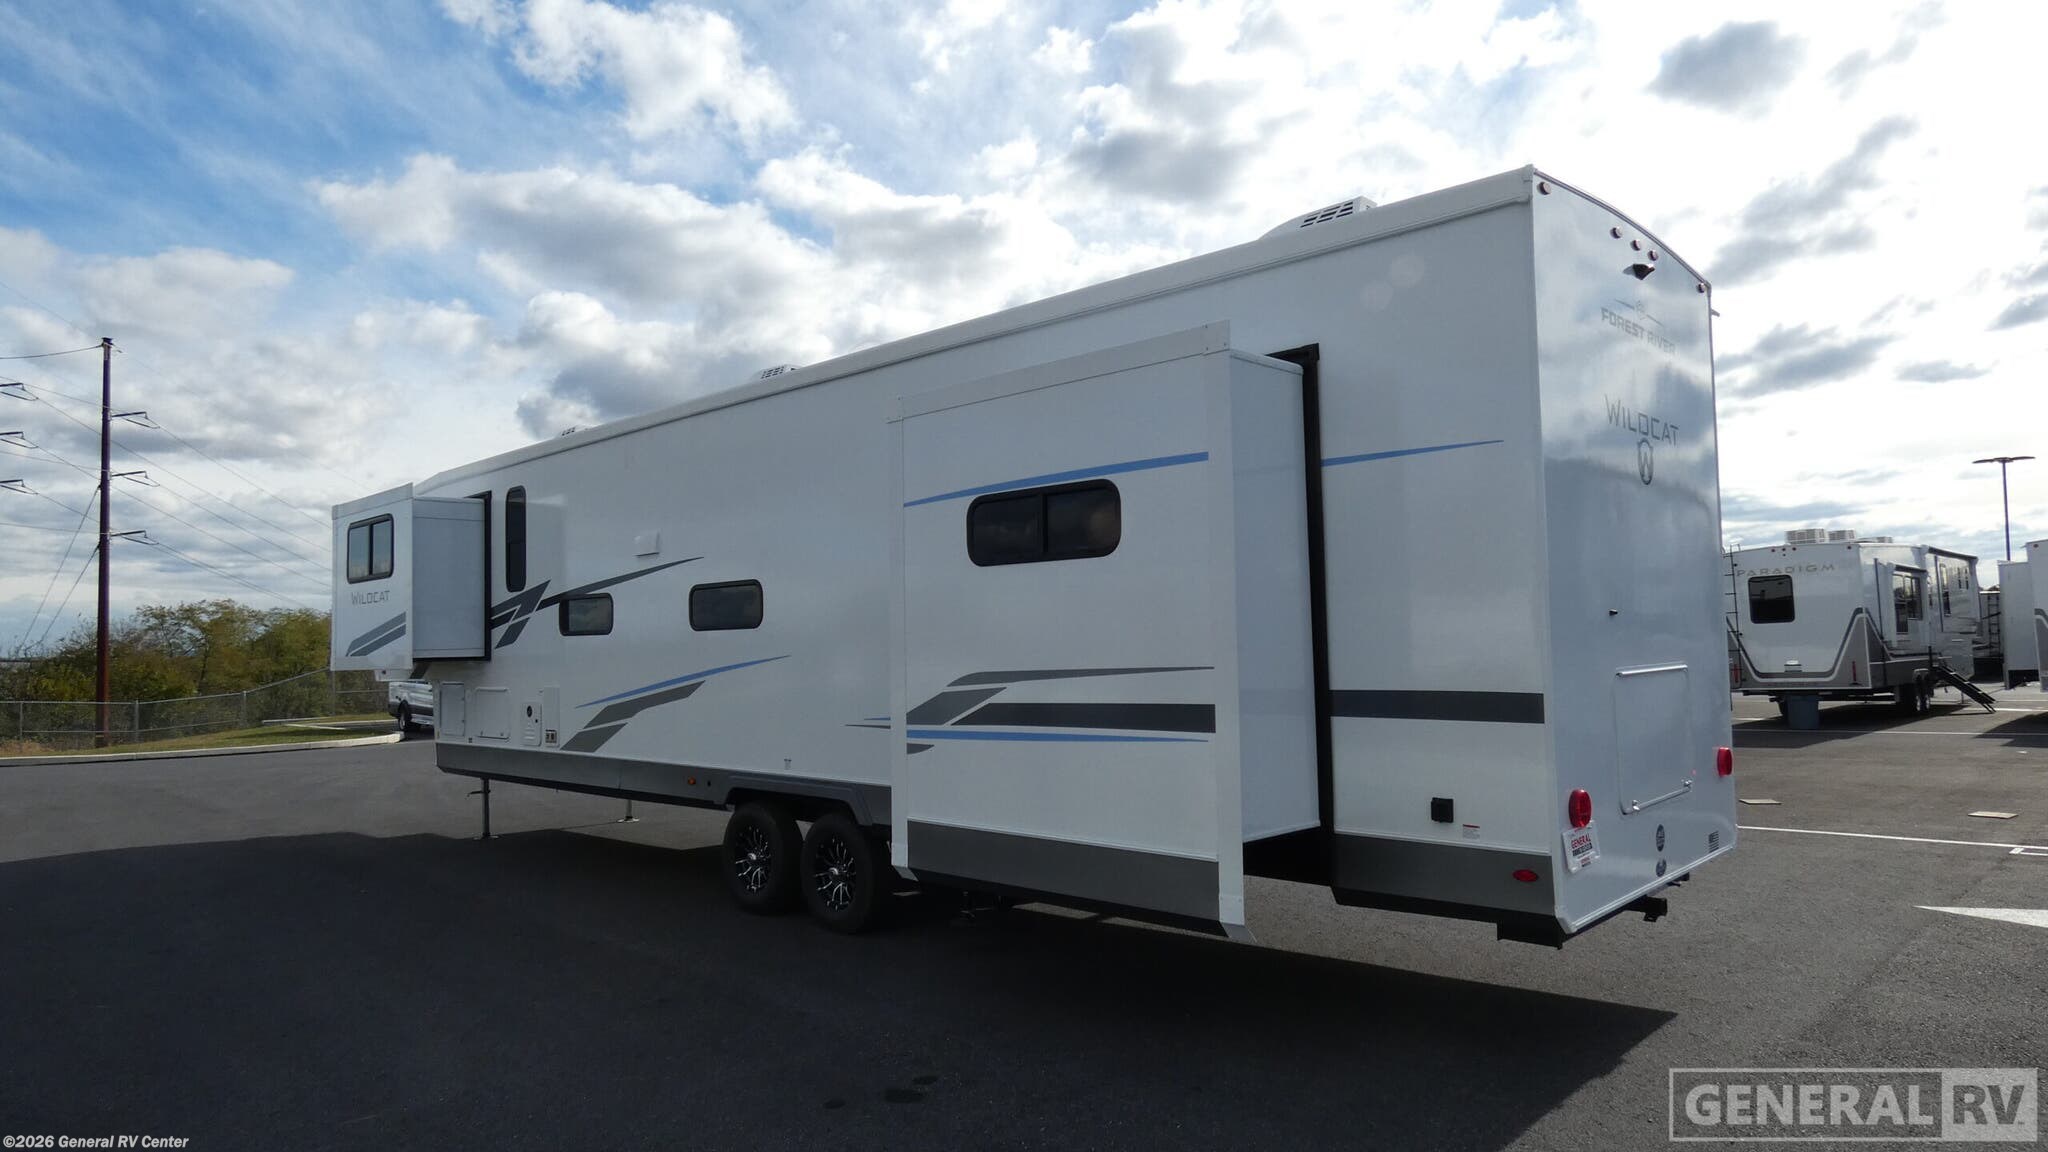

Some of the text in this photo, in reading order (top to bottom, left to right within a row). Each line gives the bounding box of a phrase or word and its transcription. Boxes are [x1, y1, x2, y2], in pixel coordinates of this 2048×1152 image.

[1600, 307, 1676, 354] FOREST RIVER
[1605, 393, 1679, 446] WILDCAT
[1736, 563, 1835, 577] PARADIGM
[351, 590, 390, 605] WILDCAT
